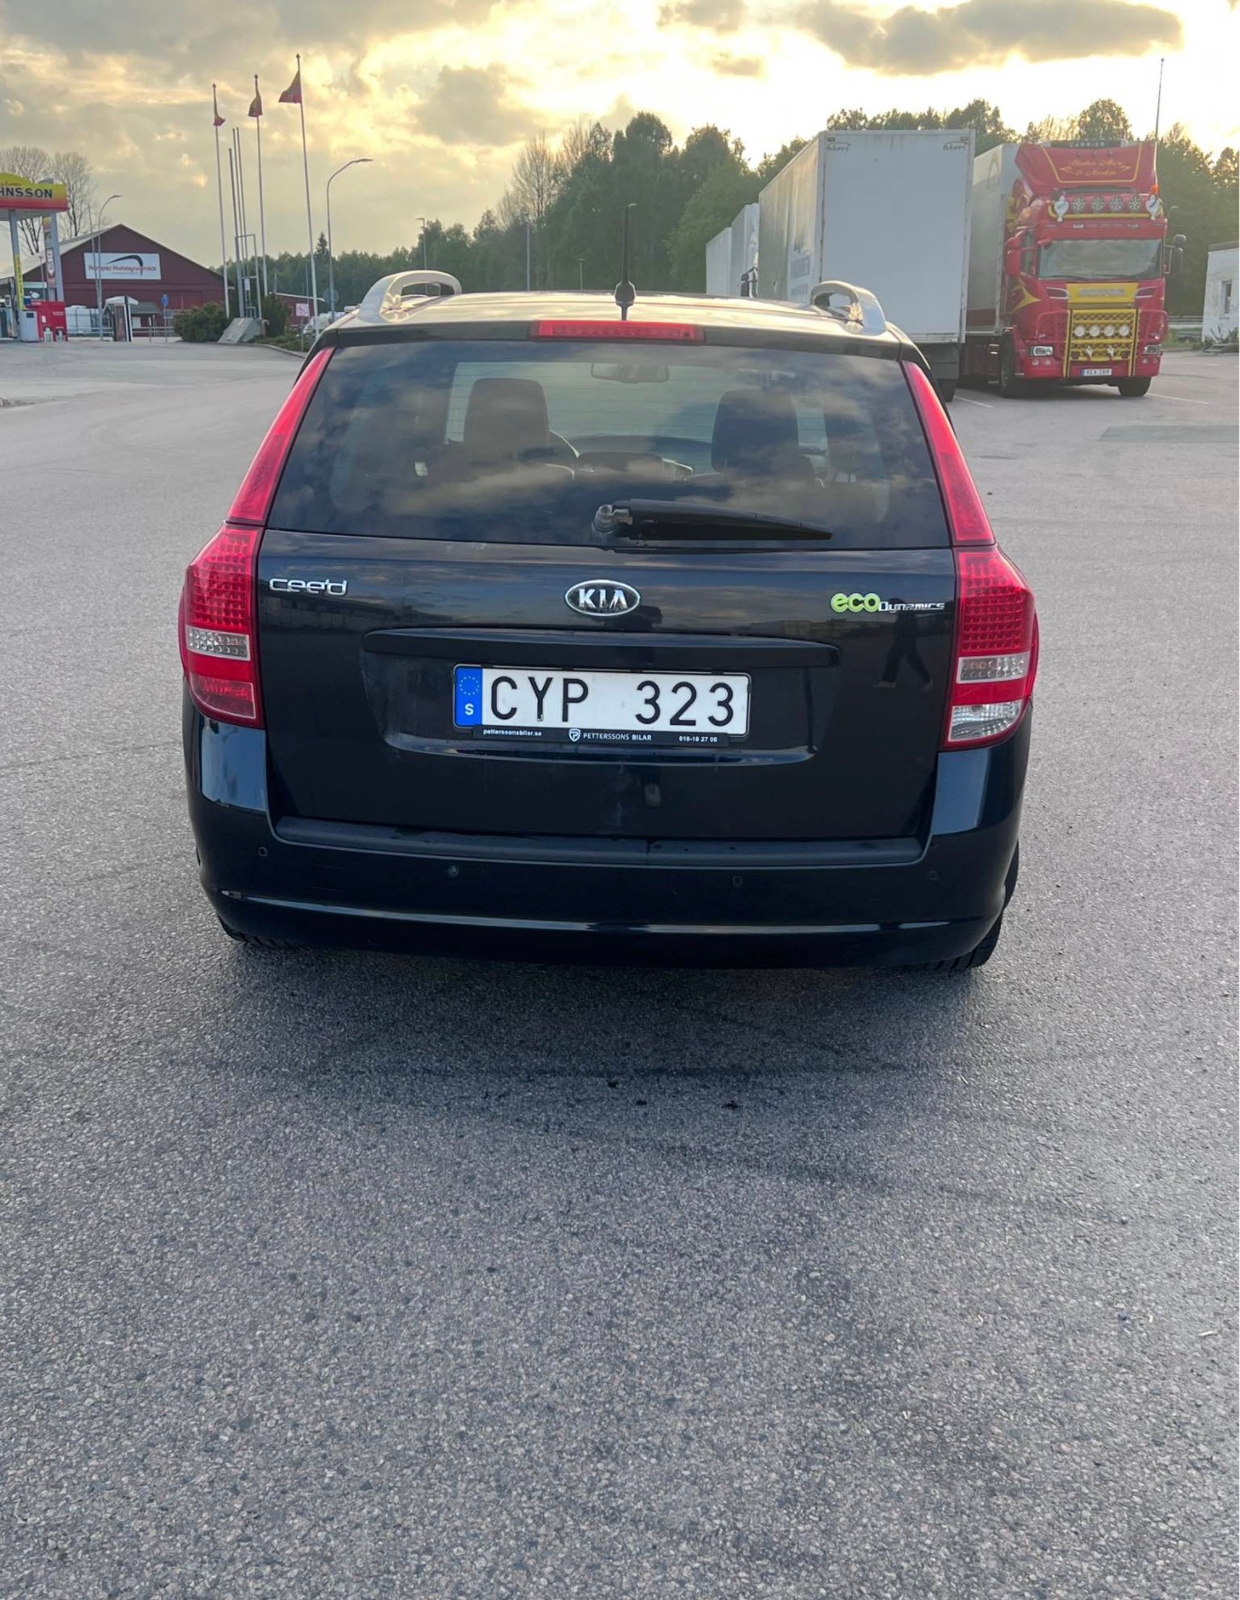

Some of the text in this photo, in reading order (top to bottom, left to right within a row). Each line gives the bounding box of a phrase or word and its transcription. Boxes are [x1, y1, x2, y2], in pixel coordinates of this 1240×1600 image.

[578, 588, 628, 609] KIA
[464, 703, 475, 716] S
[490, 676, 735, 727] CYP 323
[583, 733, 630, 741] PETTERSSONS
